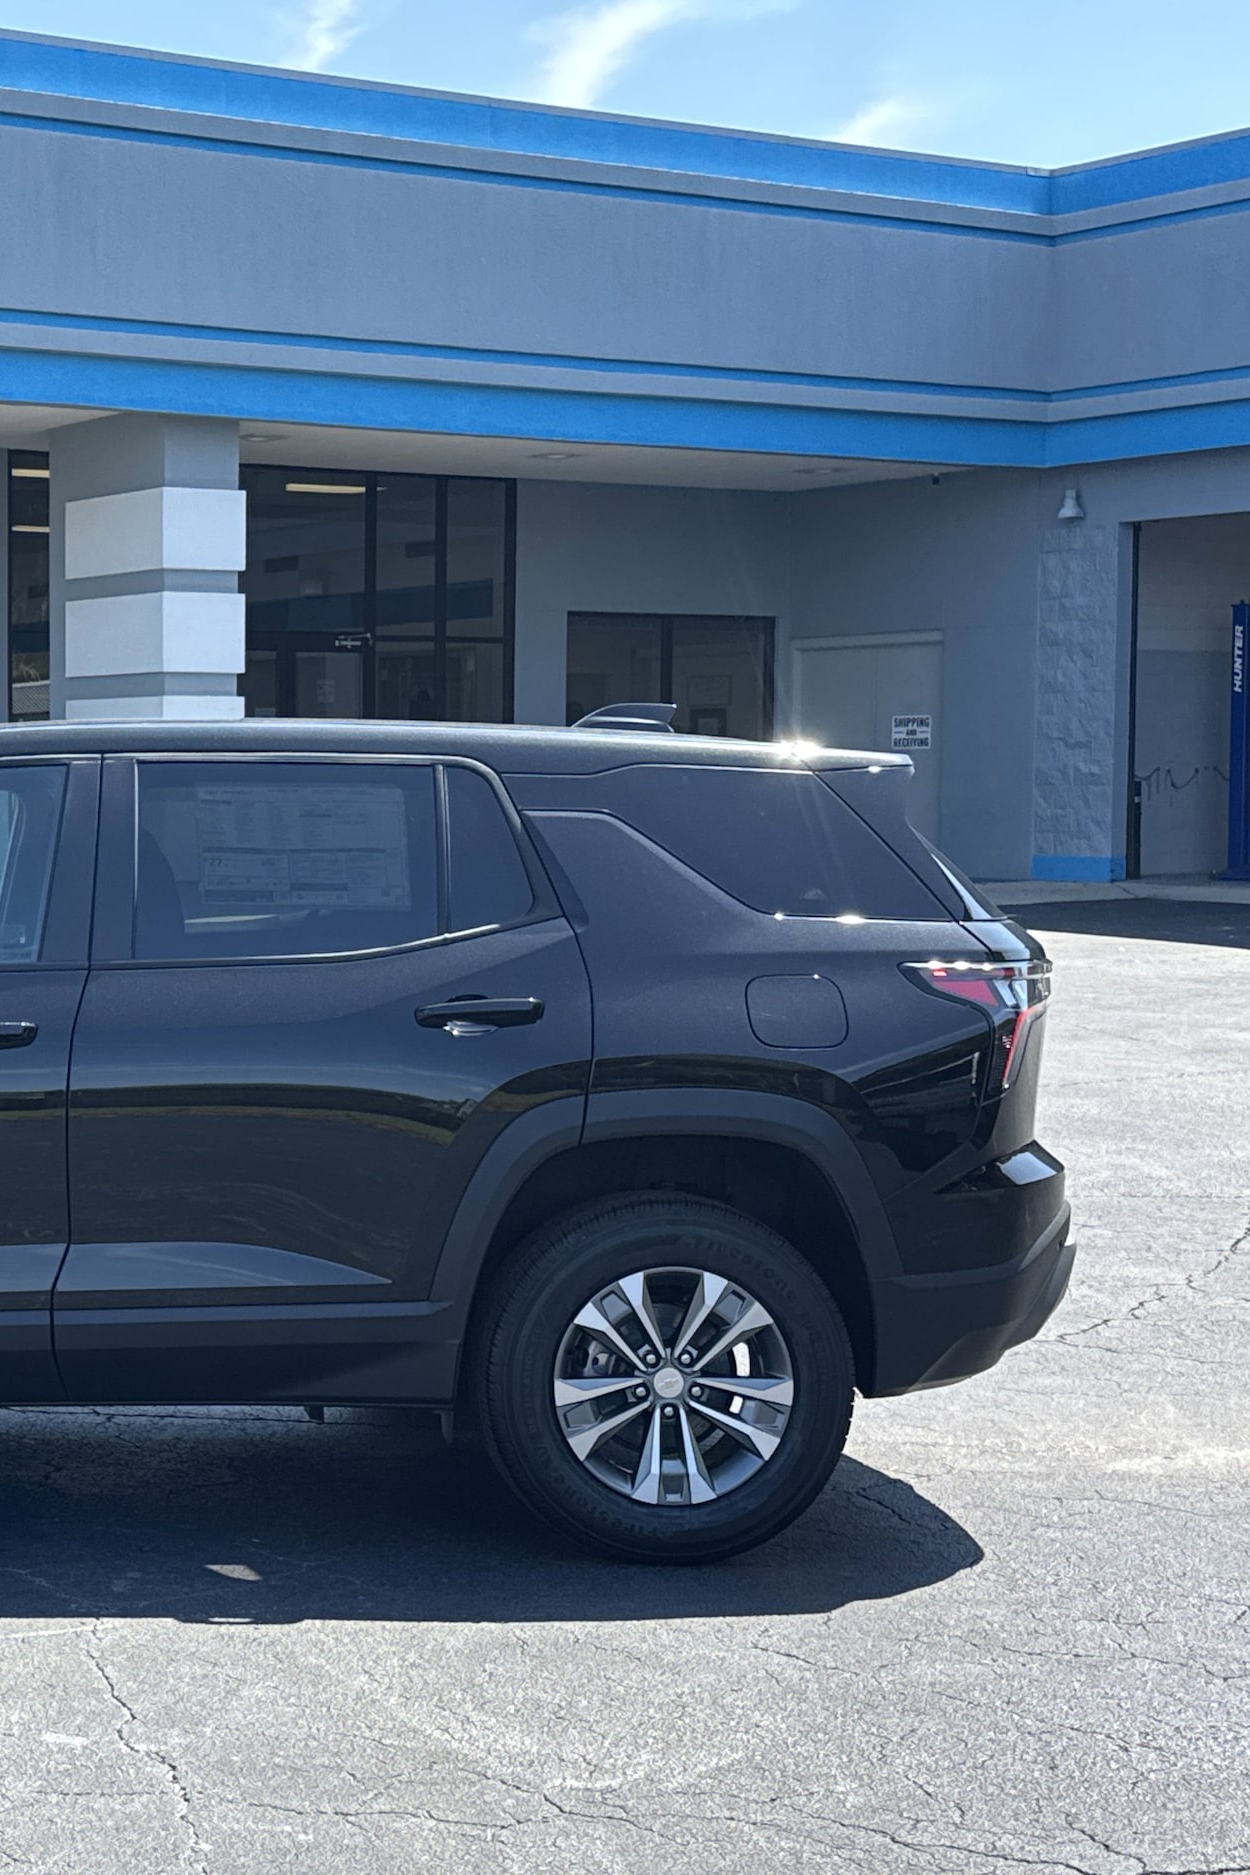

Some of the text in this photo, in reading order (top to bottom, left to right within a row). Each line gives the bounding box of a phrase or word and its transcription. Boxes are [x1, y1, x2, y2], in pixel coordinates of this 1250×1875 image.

[1233, 625, 1244, 693] HUNTER
[894, 717, 930, 728] SHIPPING
[894, 737, 929, 748] RECEIVING
